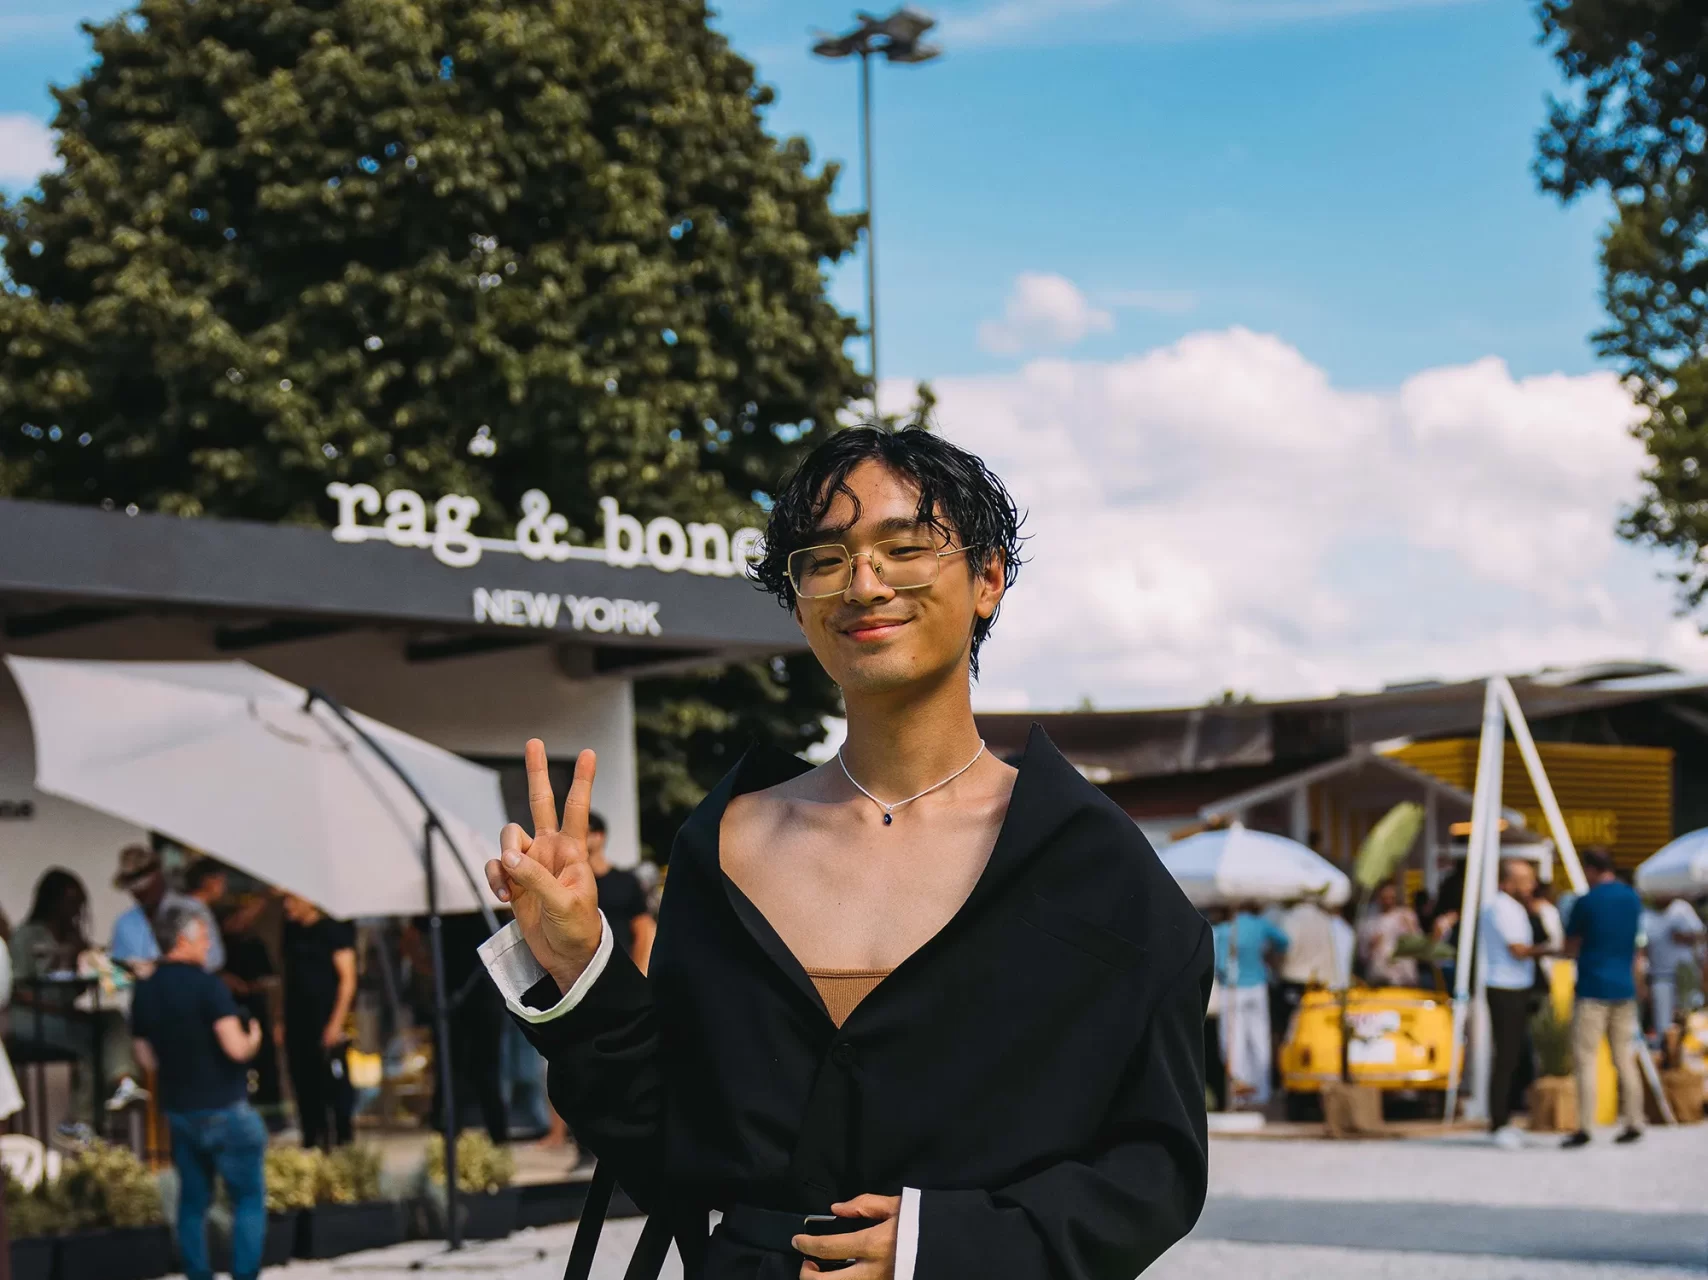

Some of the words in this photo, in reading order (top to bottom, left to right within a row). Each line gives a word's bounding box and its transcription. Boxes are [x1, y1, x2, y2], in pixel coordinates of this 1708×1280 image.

[326, 481, 482, 568] rag
[516, 488, 571, 562] &
[599, 495, 767, 580] bone
[473, 587, 561, 629] NEW
[564, 594, 663, 637] YORK
